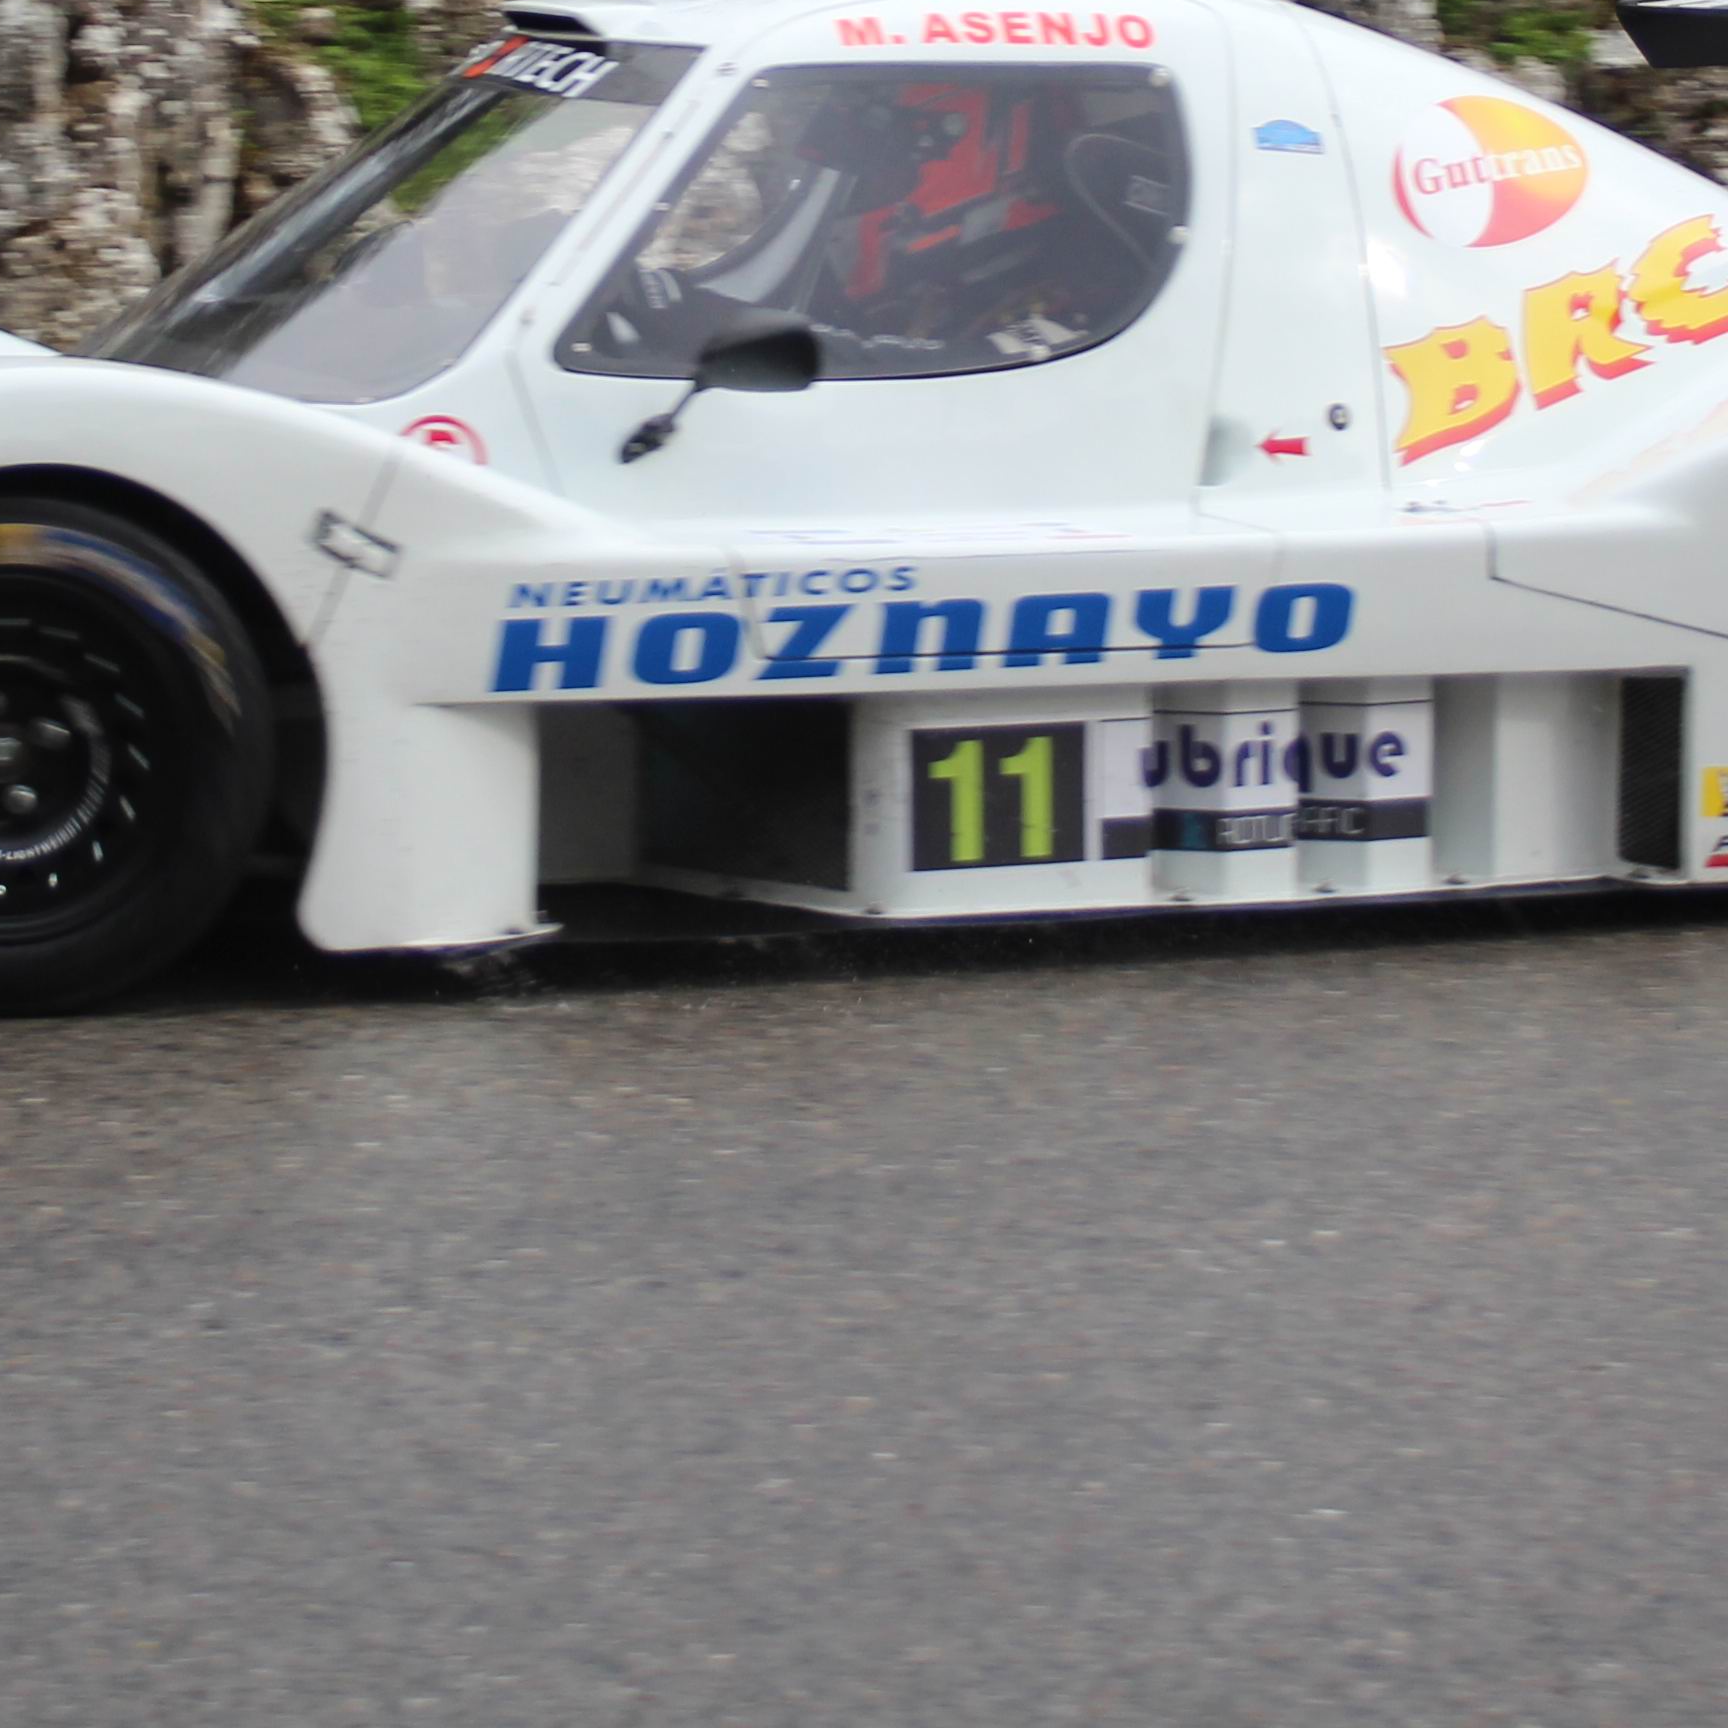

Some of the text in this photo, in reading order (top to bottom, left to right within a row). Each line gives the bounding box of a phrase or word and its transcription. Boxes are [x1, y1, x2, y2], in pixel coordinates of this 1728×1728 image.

[836, 10, 1154, 49] M. ASENJO
[506, 565, 920, 610] NEUMÁTICOS
[1138, 719, 1407, 794] ubrique
[928, 735, 1054, 863] 11
